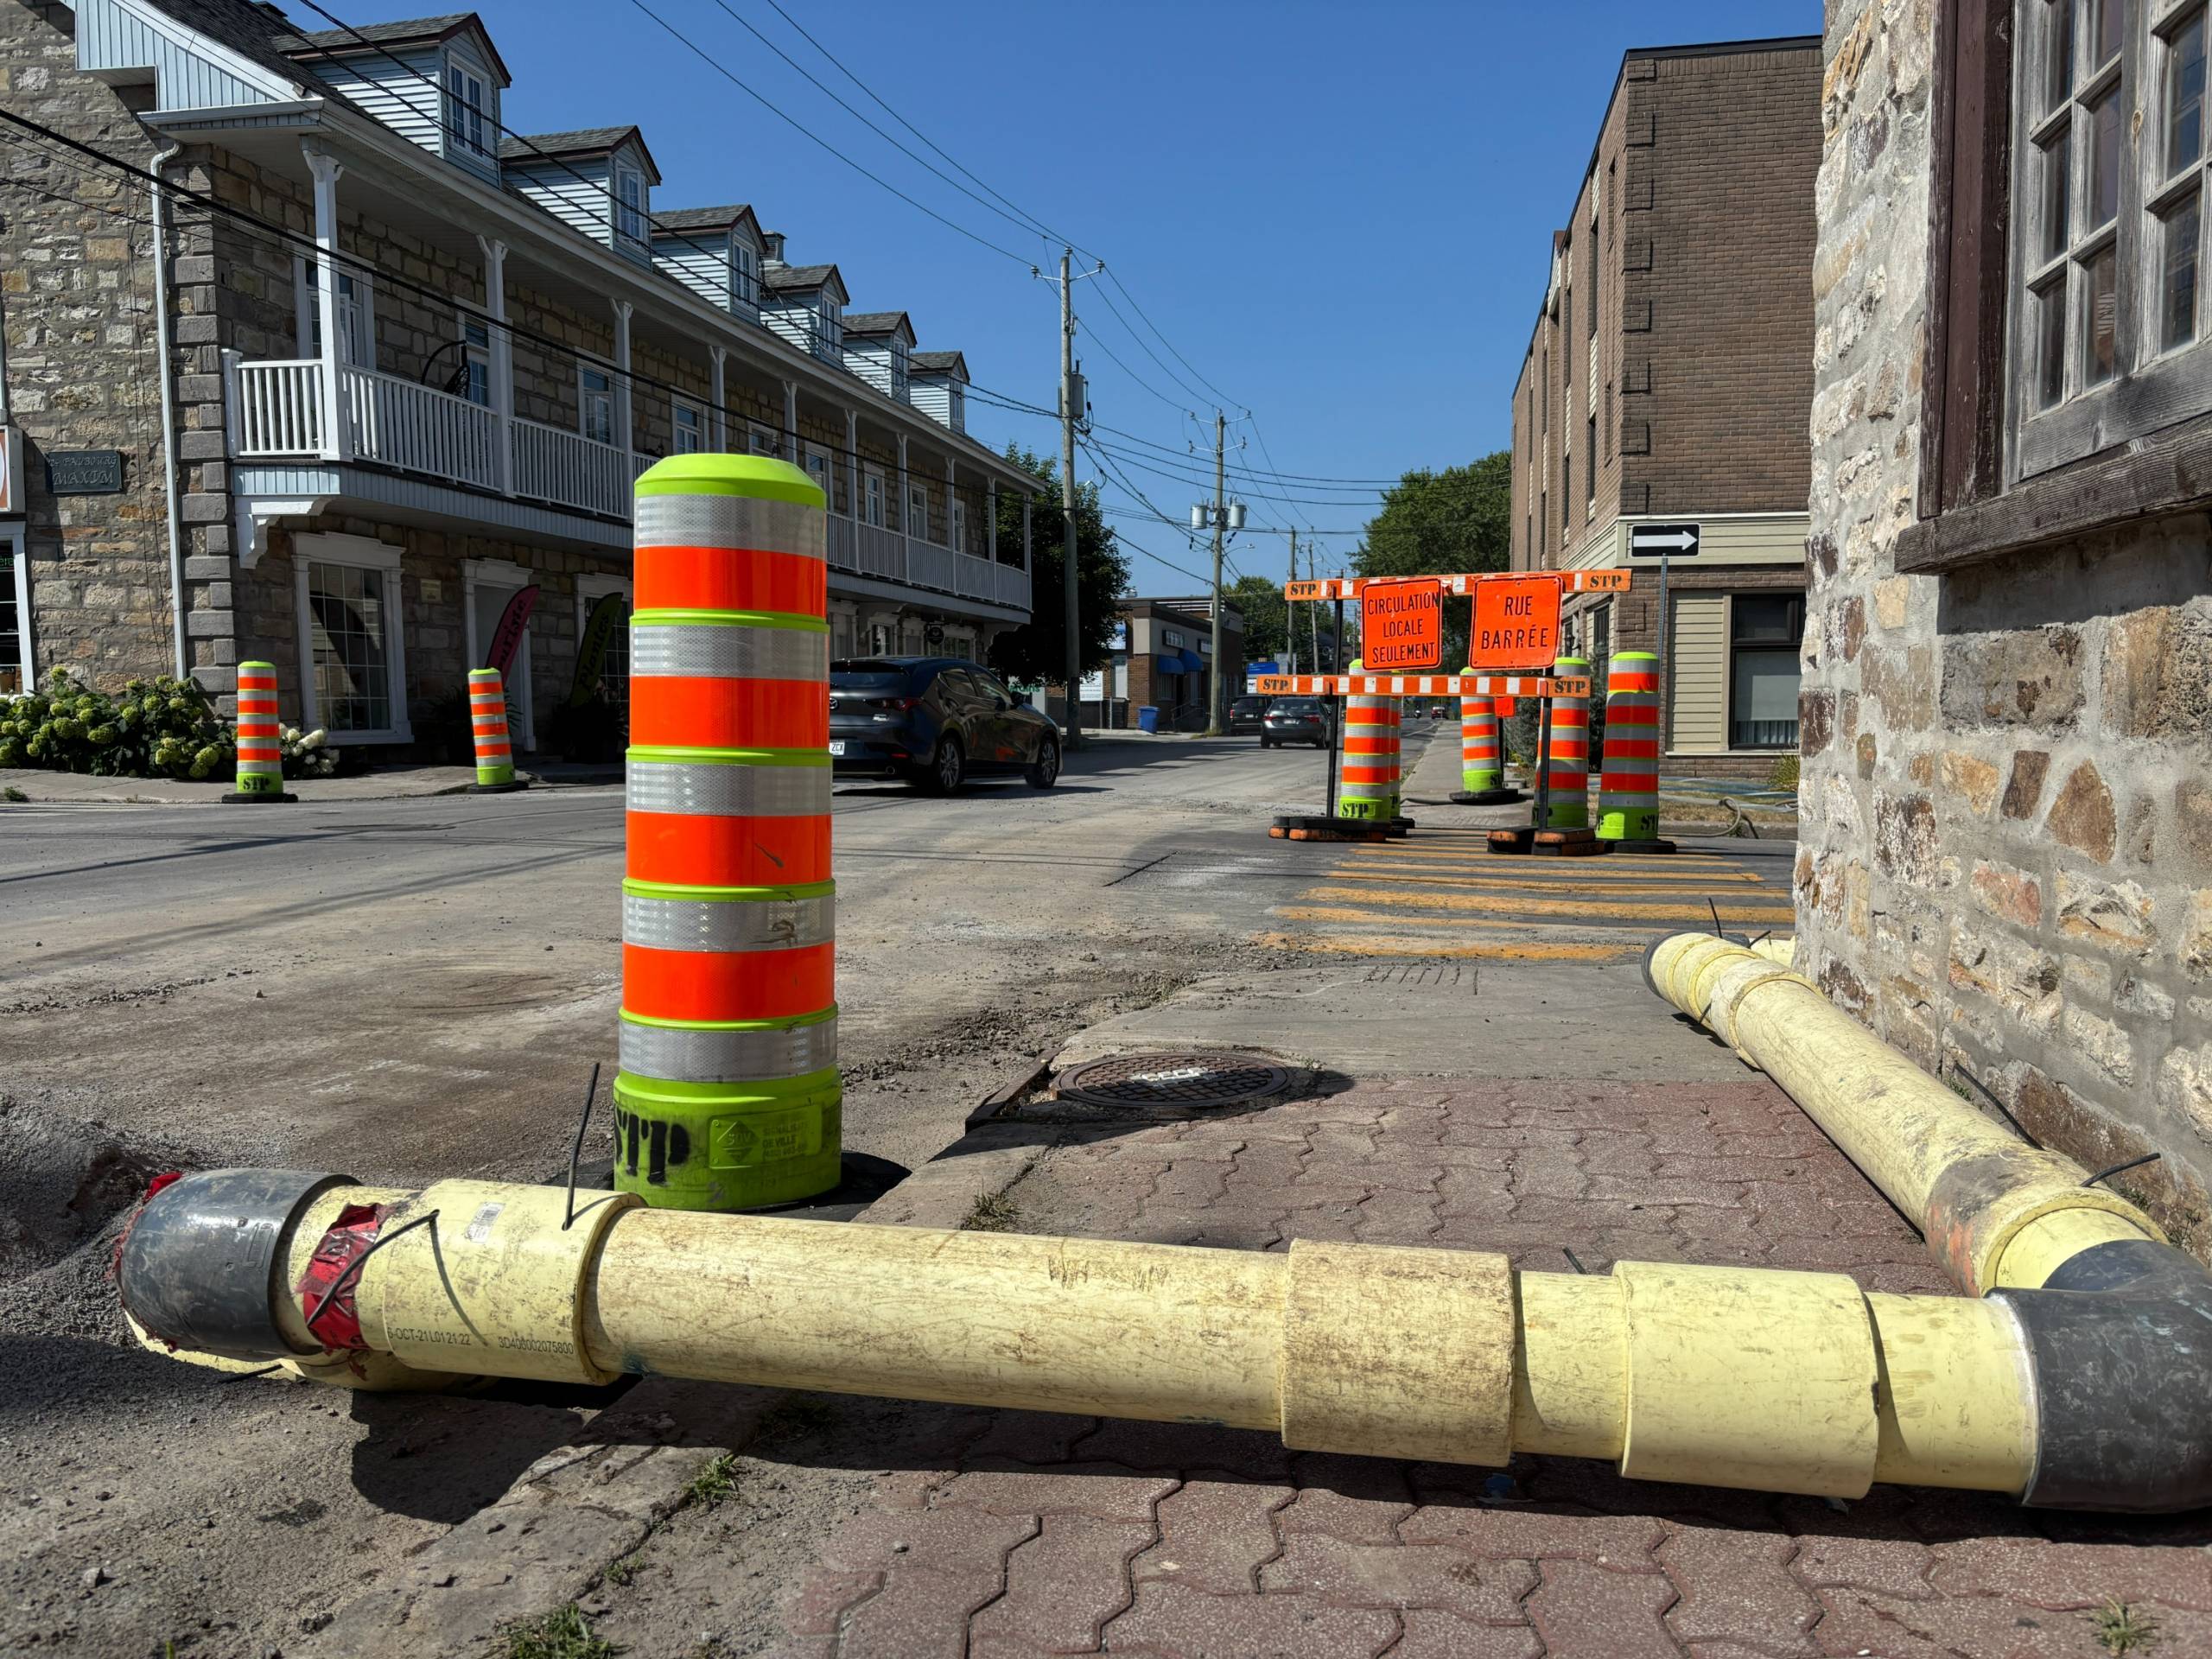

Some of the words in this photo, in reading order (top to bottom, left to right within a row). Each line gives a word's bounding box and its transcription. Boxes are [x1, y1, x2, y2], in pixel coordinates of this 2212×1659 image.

[63, 455, 117, 467] FAUBOURG
[53, 469, 113, 485] MAXIM
[1290, 583, 1317, 595] STP
[1590, 575, 1622, 588] STP
[1368, 591, 1439, 615] CIRCULATION
[1504, 595, 1533, 616] RUE
[1383, 619, 1423, 638] LOCALE
[1481, 624, 1548, 650] BARRÉE
[579, 613, 610, 691] Plantes
[1372, 642, 1435, 664] SEULEMENT
[1262, 678, 1288, 691] STP
[1554, 680, 1586, 693] STP
[242, 776, 270, 790] STP
[1342, 802, 1369, 818] STP
